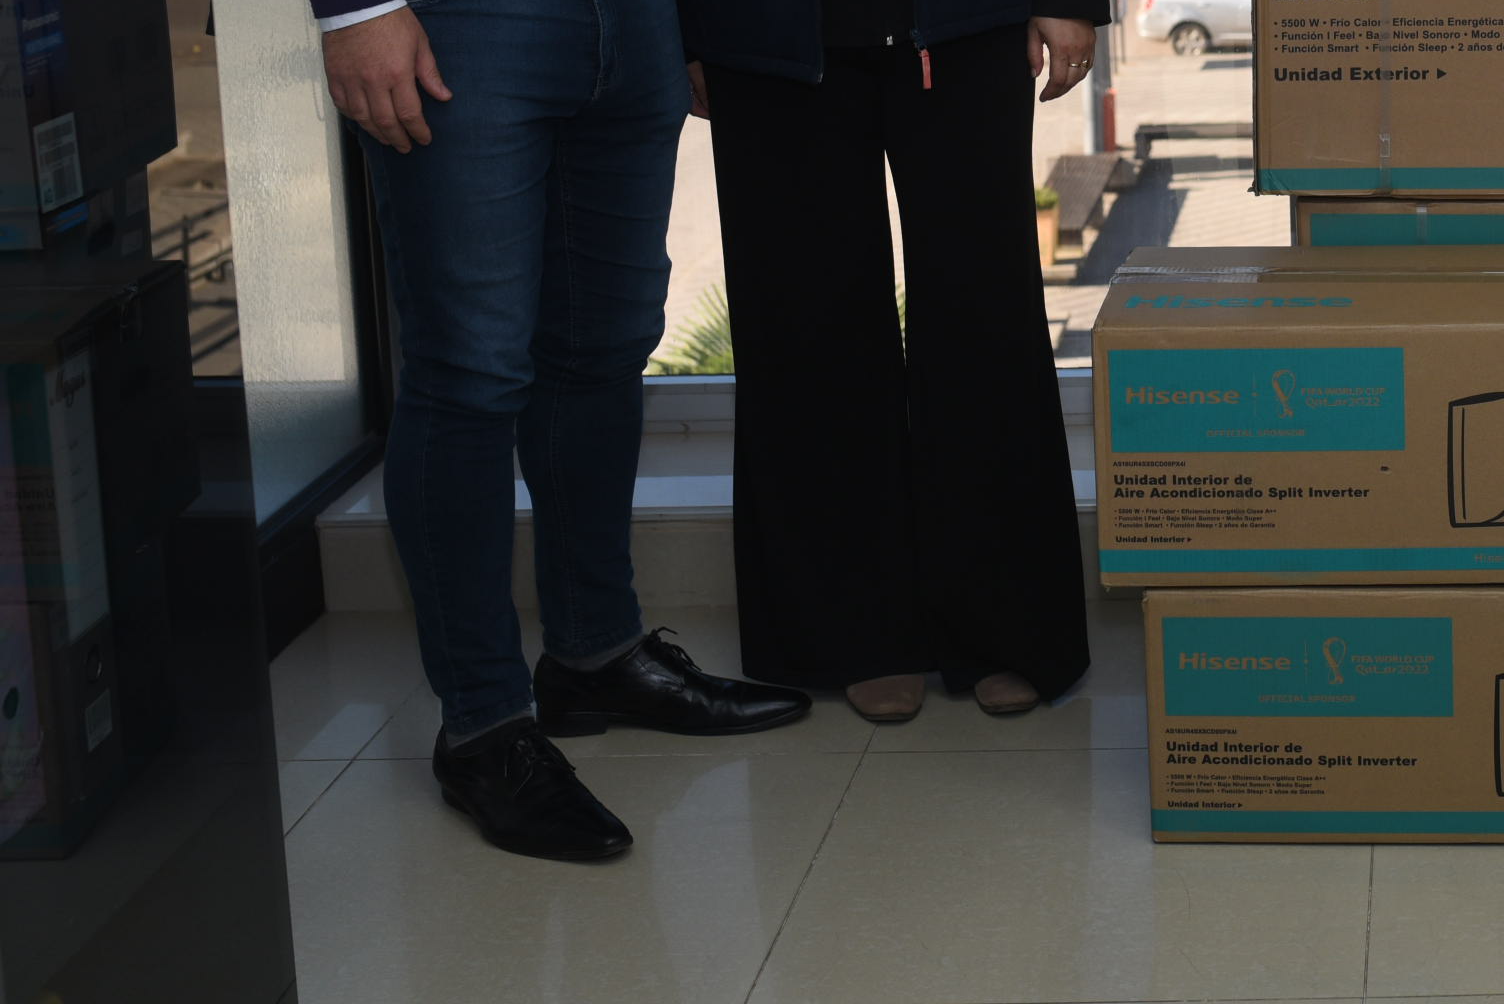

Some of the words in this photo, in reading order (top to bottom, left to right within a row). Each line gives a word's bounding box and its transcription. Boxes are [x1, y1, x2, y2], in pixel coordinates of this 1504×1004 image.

[1281, 18, 1306, 27] 5500
[1308, 18, 1319, 27] W
[1354, 17, 1383, 27] Calor
[1393, 17, 1444, 26] Eficiencia
[1448, 16, 1504, 28] Energética
[1282, 31, 1324, 40] Función
[1333, 31, 1355, 40] Feel
[1393, 30, 1419, 39] Nivel
[1423, 30, 1461, 39] Sonoro
[1472, 30, 1500, 39] Modo
[1282, 43, 1324, 53] Función
[1327, 44, 1359, 53] Smart
[1418, 42, 1448, 54] Sleep
[1458, 43, 1465, 52] 2
[1467, 43, 1492, 52] años
[1274, 67, 1342, 81] Unidad
[1350, 67, 1429, 81] Exterior
[1124, 294, 1353, 309] Hisense
[1125, 386, 1240, 404] Hisense
[1113, 474, 1167, 485] Unidad
[1173, 474, 1230, 485] Interior
[1234, 474, 1252, 485] de
[1114, 487, 1144, 498] Aire
[1150, 487, 1262, 498] Acondicionado
[1268, 487, 1303, 500] Split
[1309, 487, 1369, 498] Inverter
[1116, 535, 1148, 543] Unidad
[1150, 535, 1185, 543] Interior
[1178, 652, 1291, 671] Hisense
[1166, 741, 1218, 753] Unidad
[1223, 742, 1280, 753] Interior
[1284, 742, 1303, 753] de
[1166, 754, 1197, 765] Aire
[1202, 754, 1313, 766] Acondicionado
[1318, 755, 1352, 768] Split
[1357, 756, 1418, 766] Inverter
[1168, 800, 1199, 808] Unidad
[1202, 801, 1235, 809] Interior
